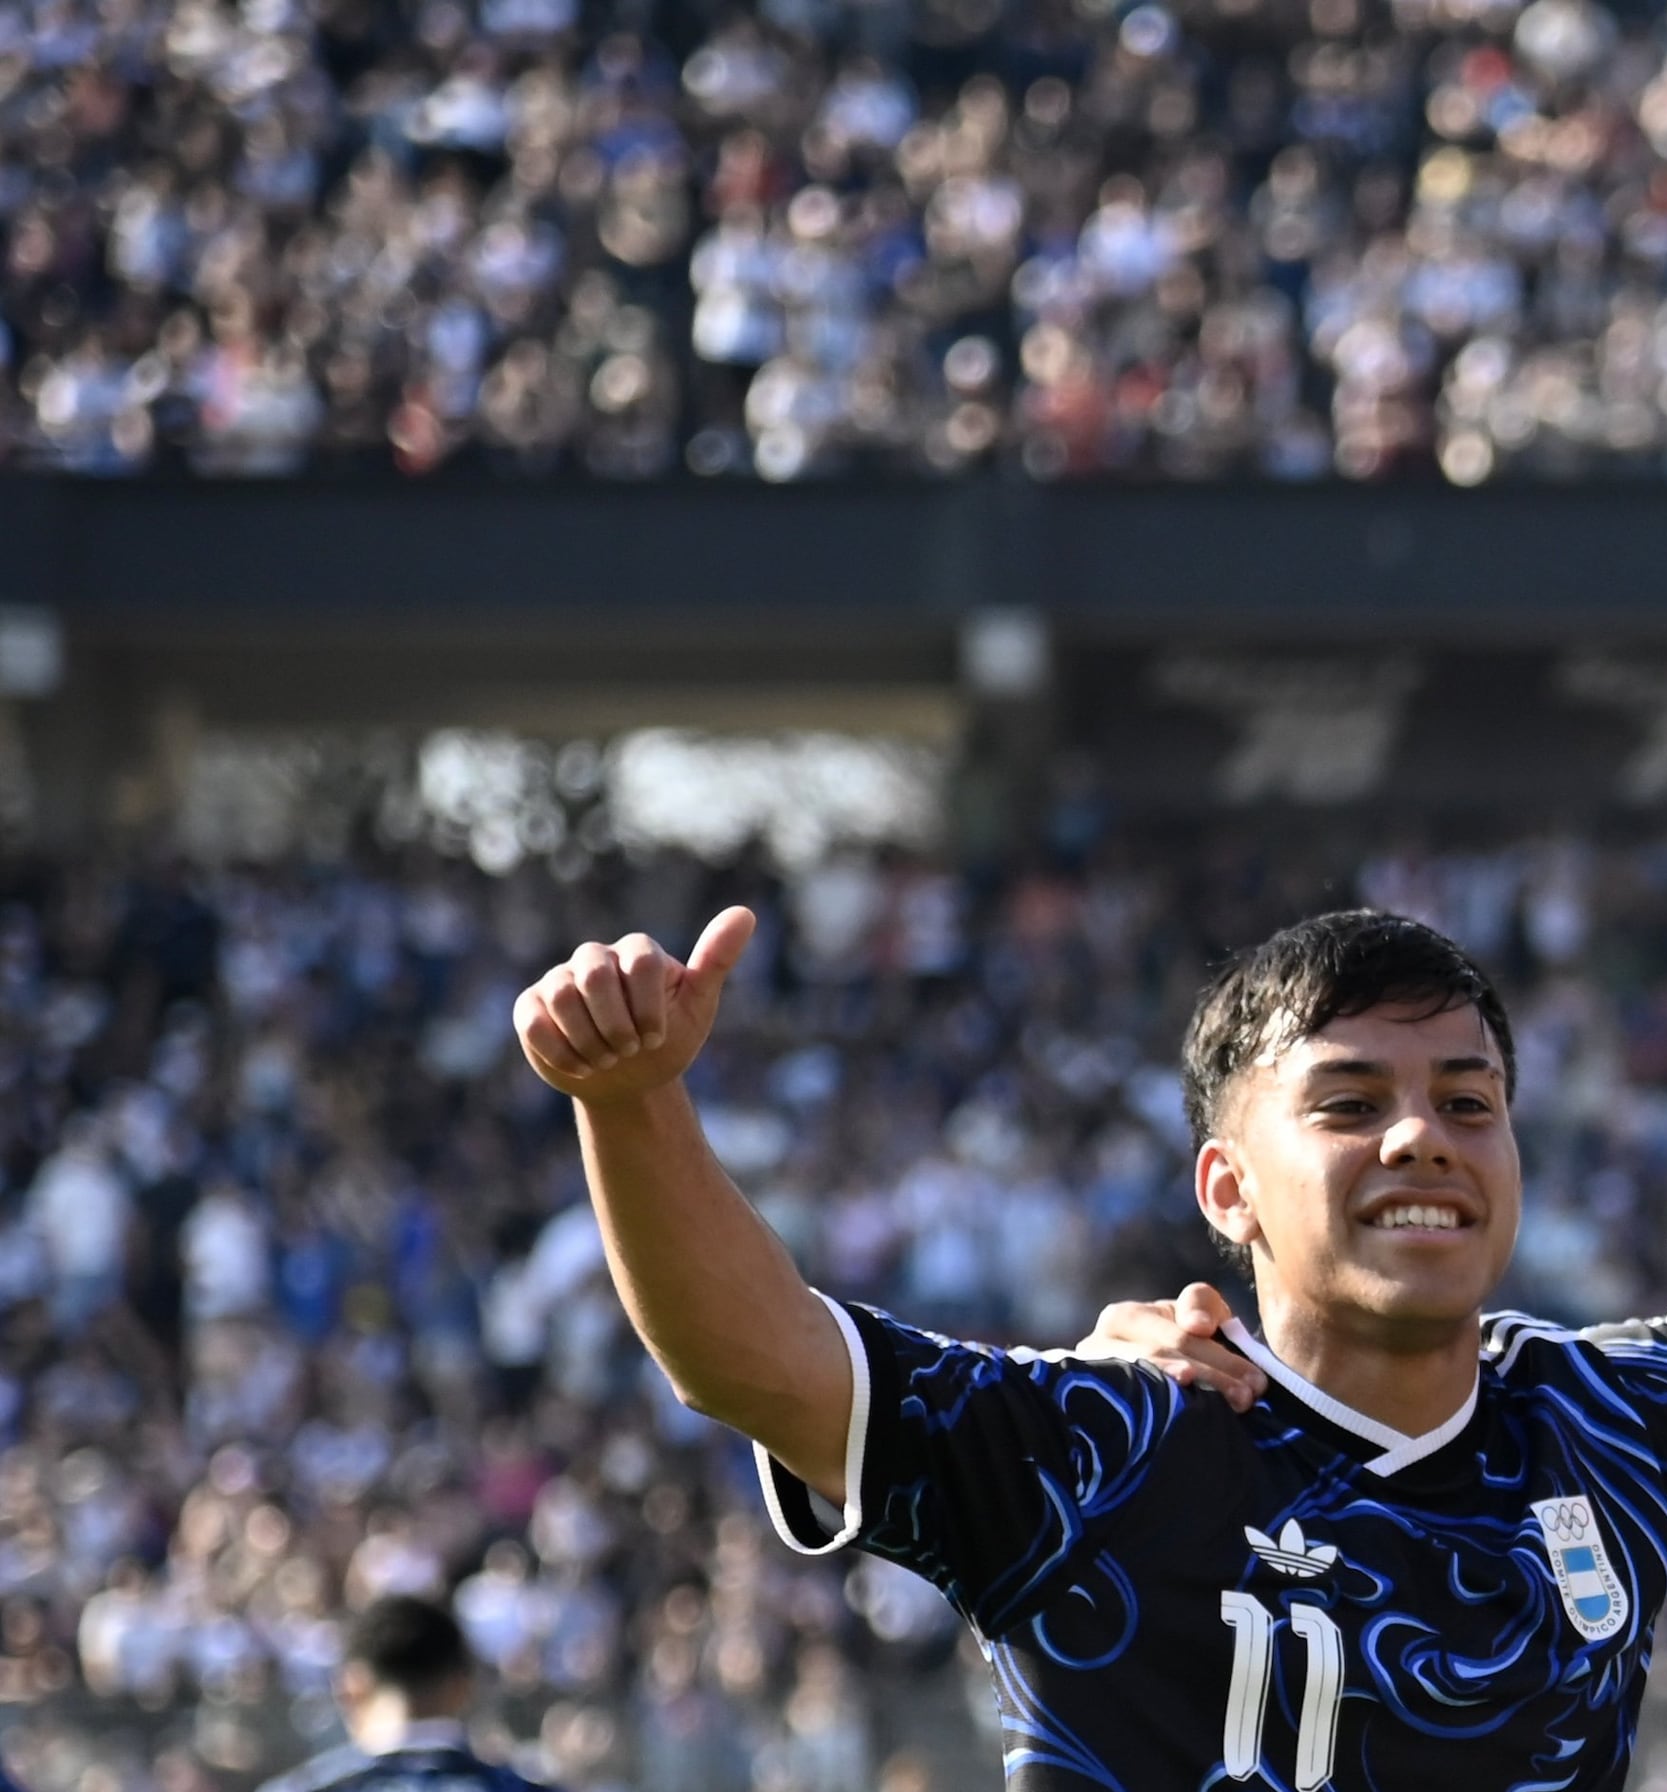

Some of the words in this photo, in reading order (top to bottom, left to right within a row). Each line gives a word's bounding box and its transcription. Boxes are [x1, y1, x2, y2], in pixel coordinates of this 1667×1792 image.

[1552, 1550, 1570, 1597] COMITE
[1592, 1544, 1622, 1616] ARGENTINO
[1569, 1607, 1616, 1633] OLIMPICO
